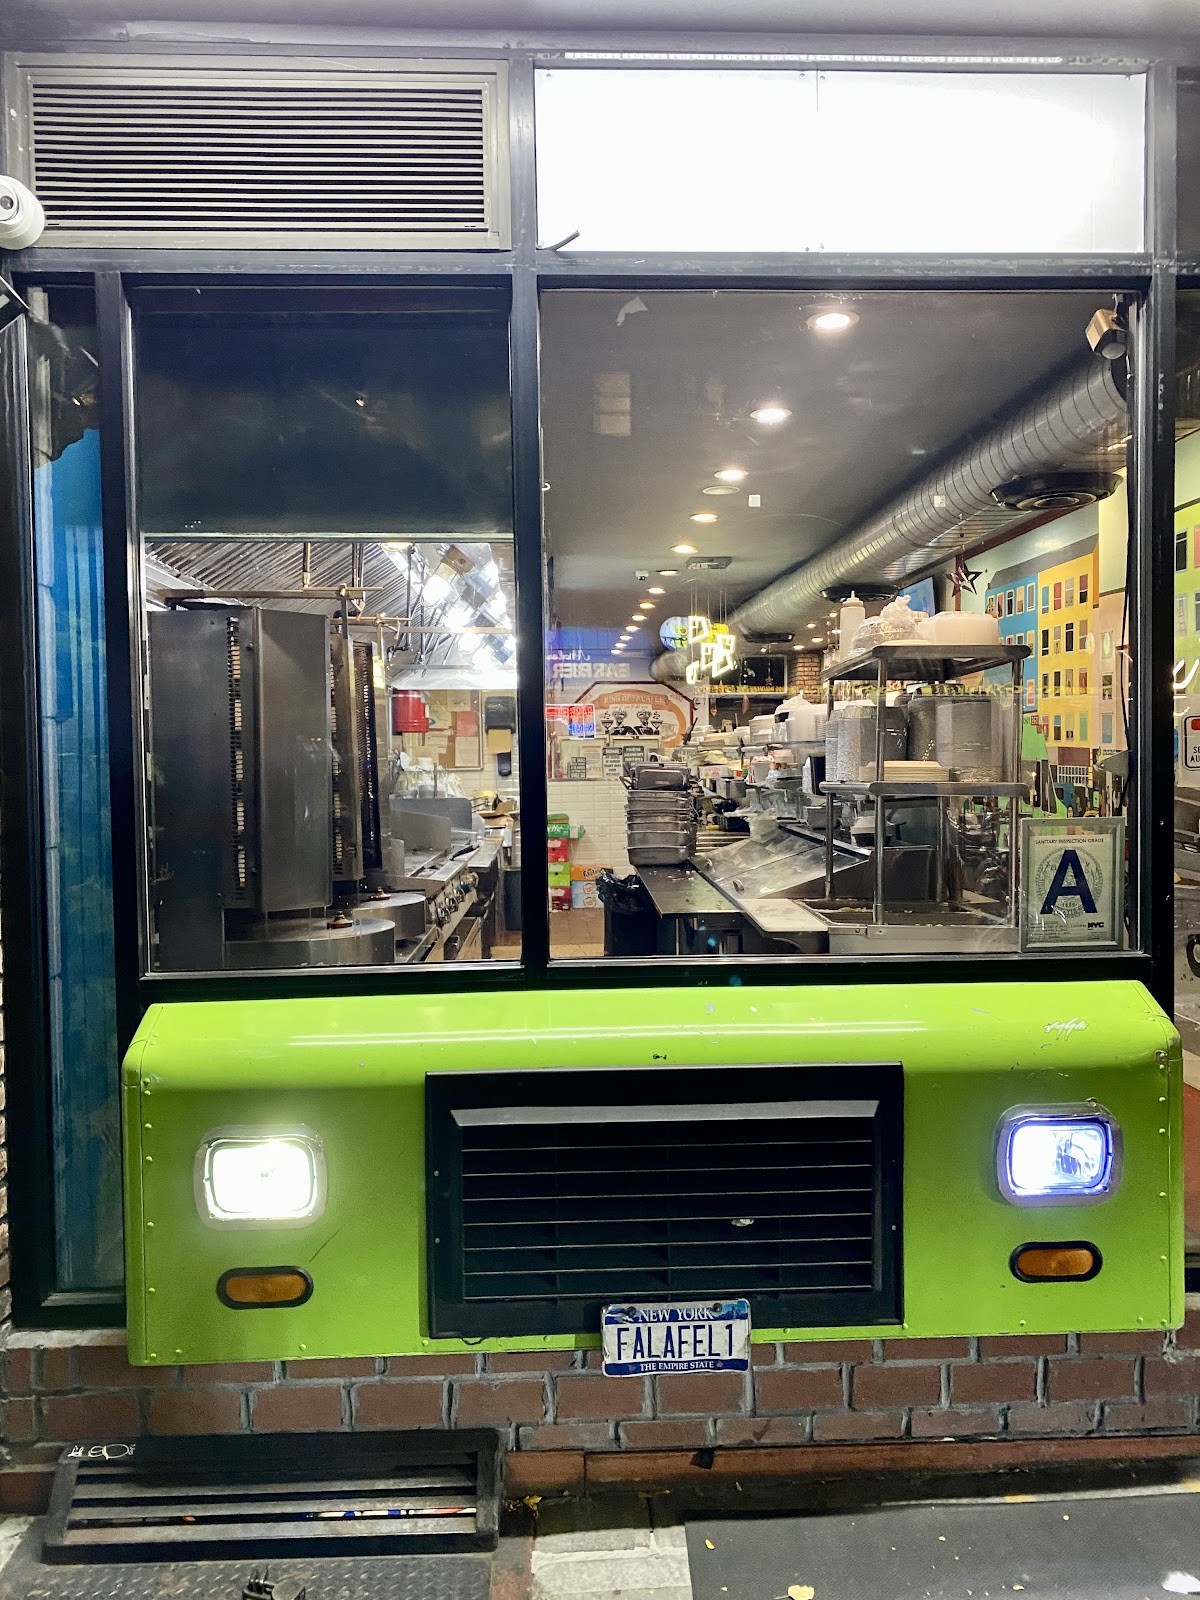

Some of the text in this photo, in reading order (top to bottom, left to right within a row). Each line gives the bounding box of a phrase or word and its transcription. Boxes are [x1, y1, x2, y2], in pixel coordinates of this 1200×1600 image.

[1040, 849, 1098, 914] A
[638, 1307, 714, 1322] NEW YORK
[617, 1324, 733, 1360] FALAFEL1
[640, 1361, 714, 1371] THE EMPIRE STATE
